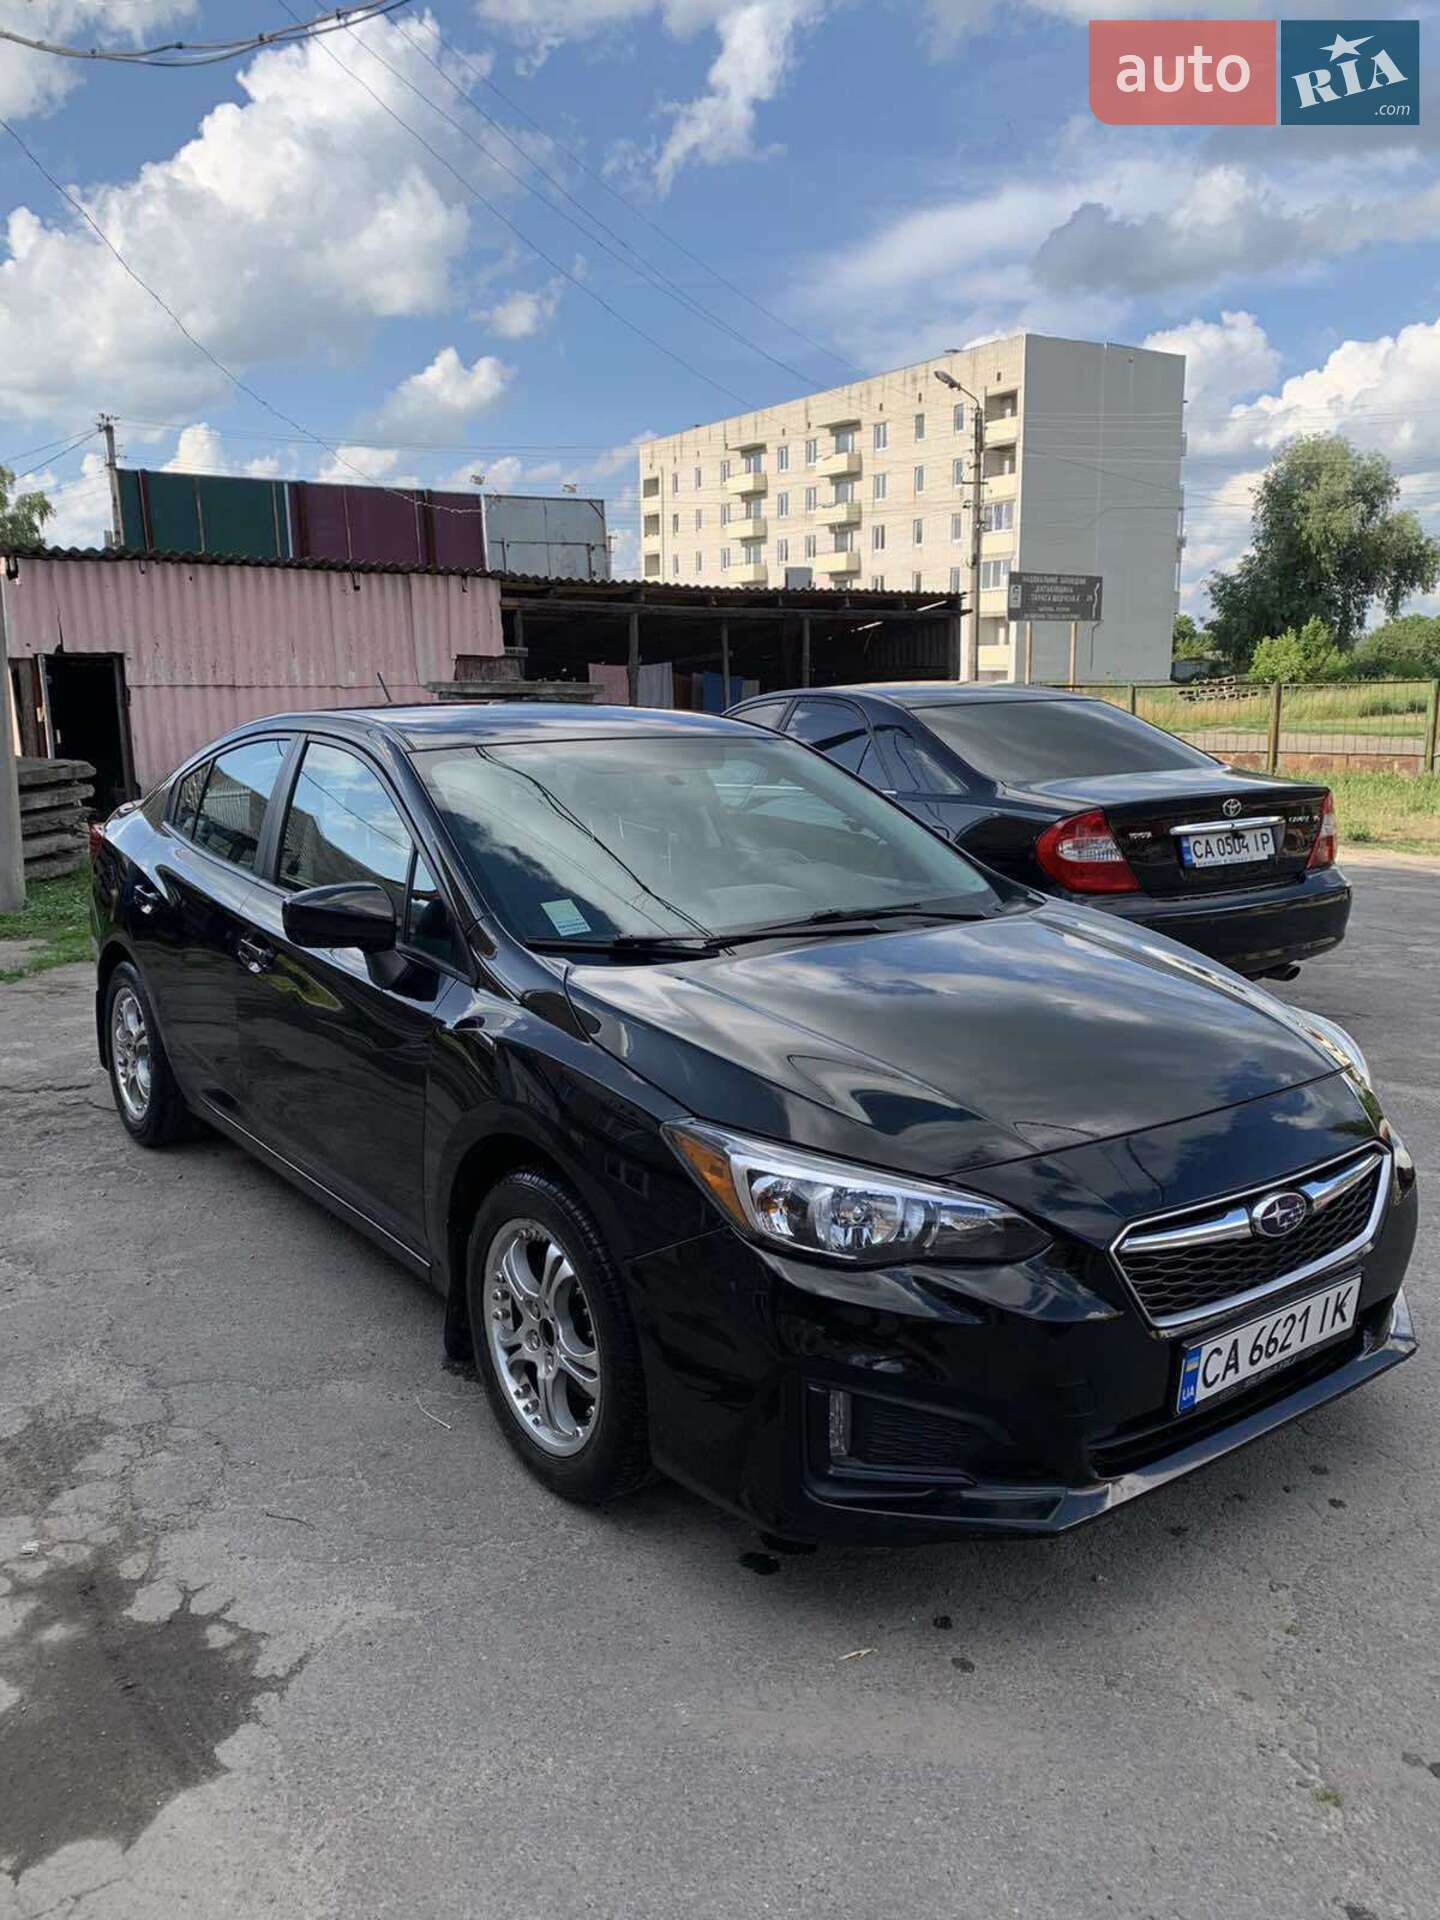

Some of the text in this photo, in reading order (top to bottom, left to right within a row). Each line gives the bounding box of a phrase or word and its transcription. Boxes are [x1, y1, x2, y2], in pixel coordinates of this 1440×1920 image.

[1192, 839, 1215, 859] CA
[1254, 832, 1270, 852] IP
[1202, 1338, 1239, 1389] CA
[1248, 1305, 1312, 1366] 6621
[1319, 1286, 1353, 1334] IK
